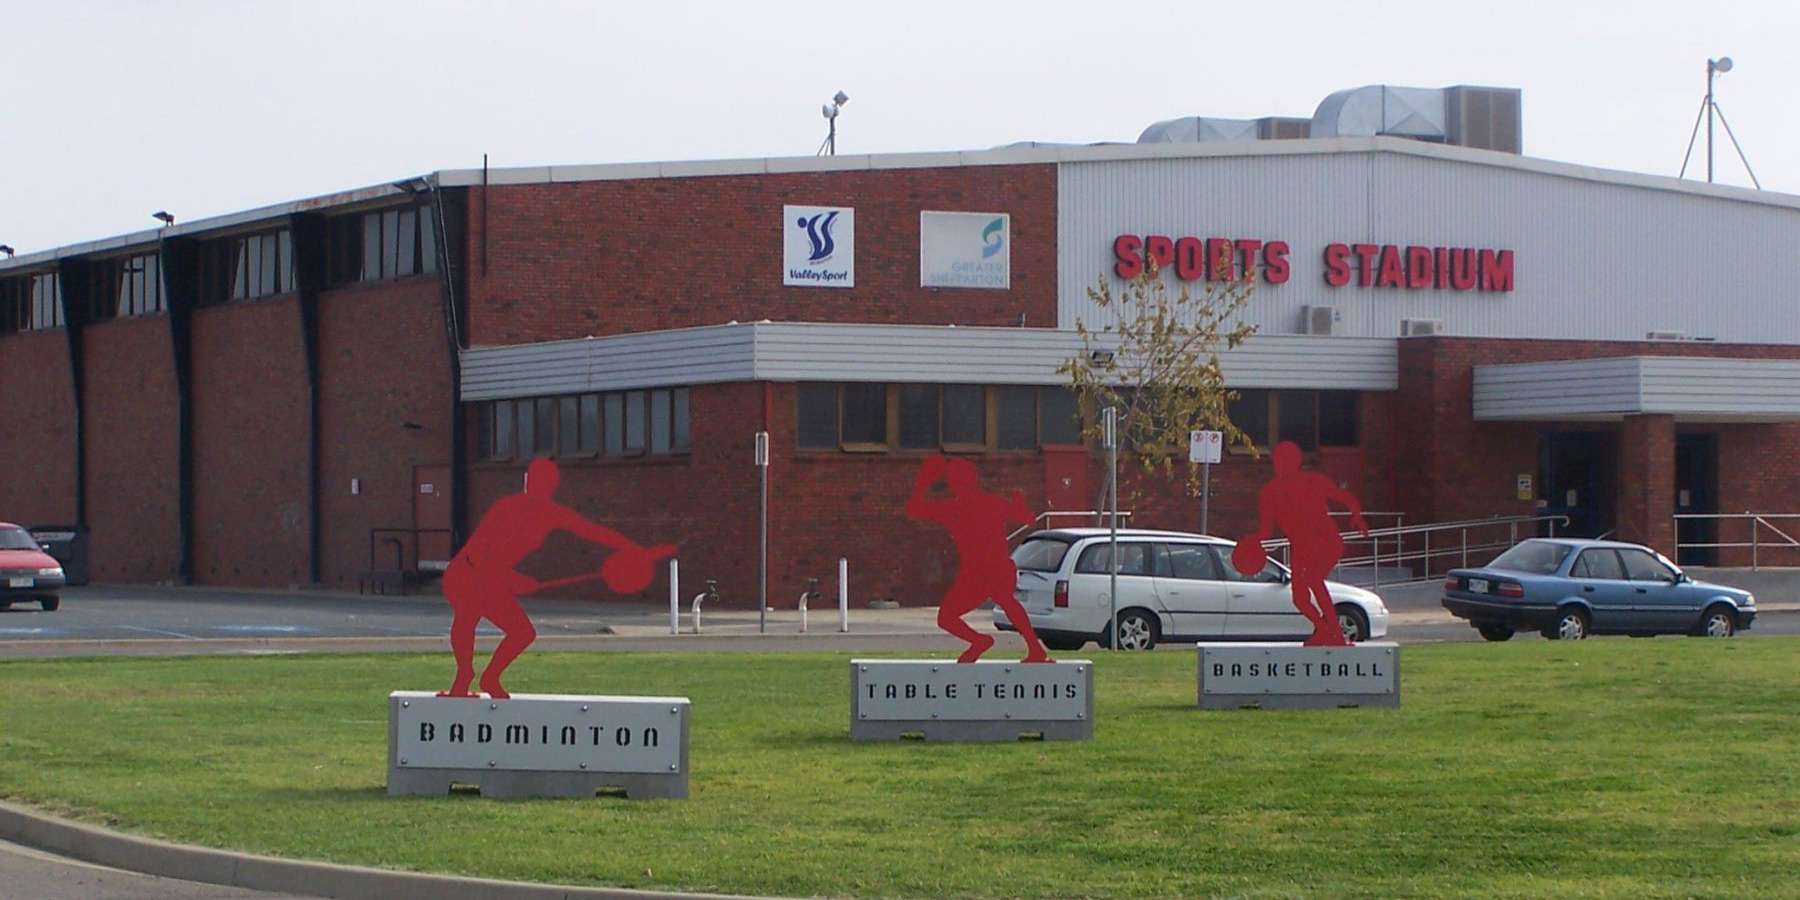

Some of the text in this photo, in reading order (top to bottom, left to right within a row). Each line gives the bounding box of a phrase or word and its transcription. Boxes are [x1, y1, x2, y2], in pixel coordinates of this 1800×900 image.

[1113, 234, 1515, 292] SPORTS STADIUM
[1213, 663, 1383, 677] BASKETBALL
[865, 683, 1078, 699] TABLE TENNIS
[419, 722, 659, 748] BADMINTON
